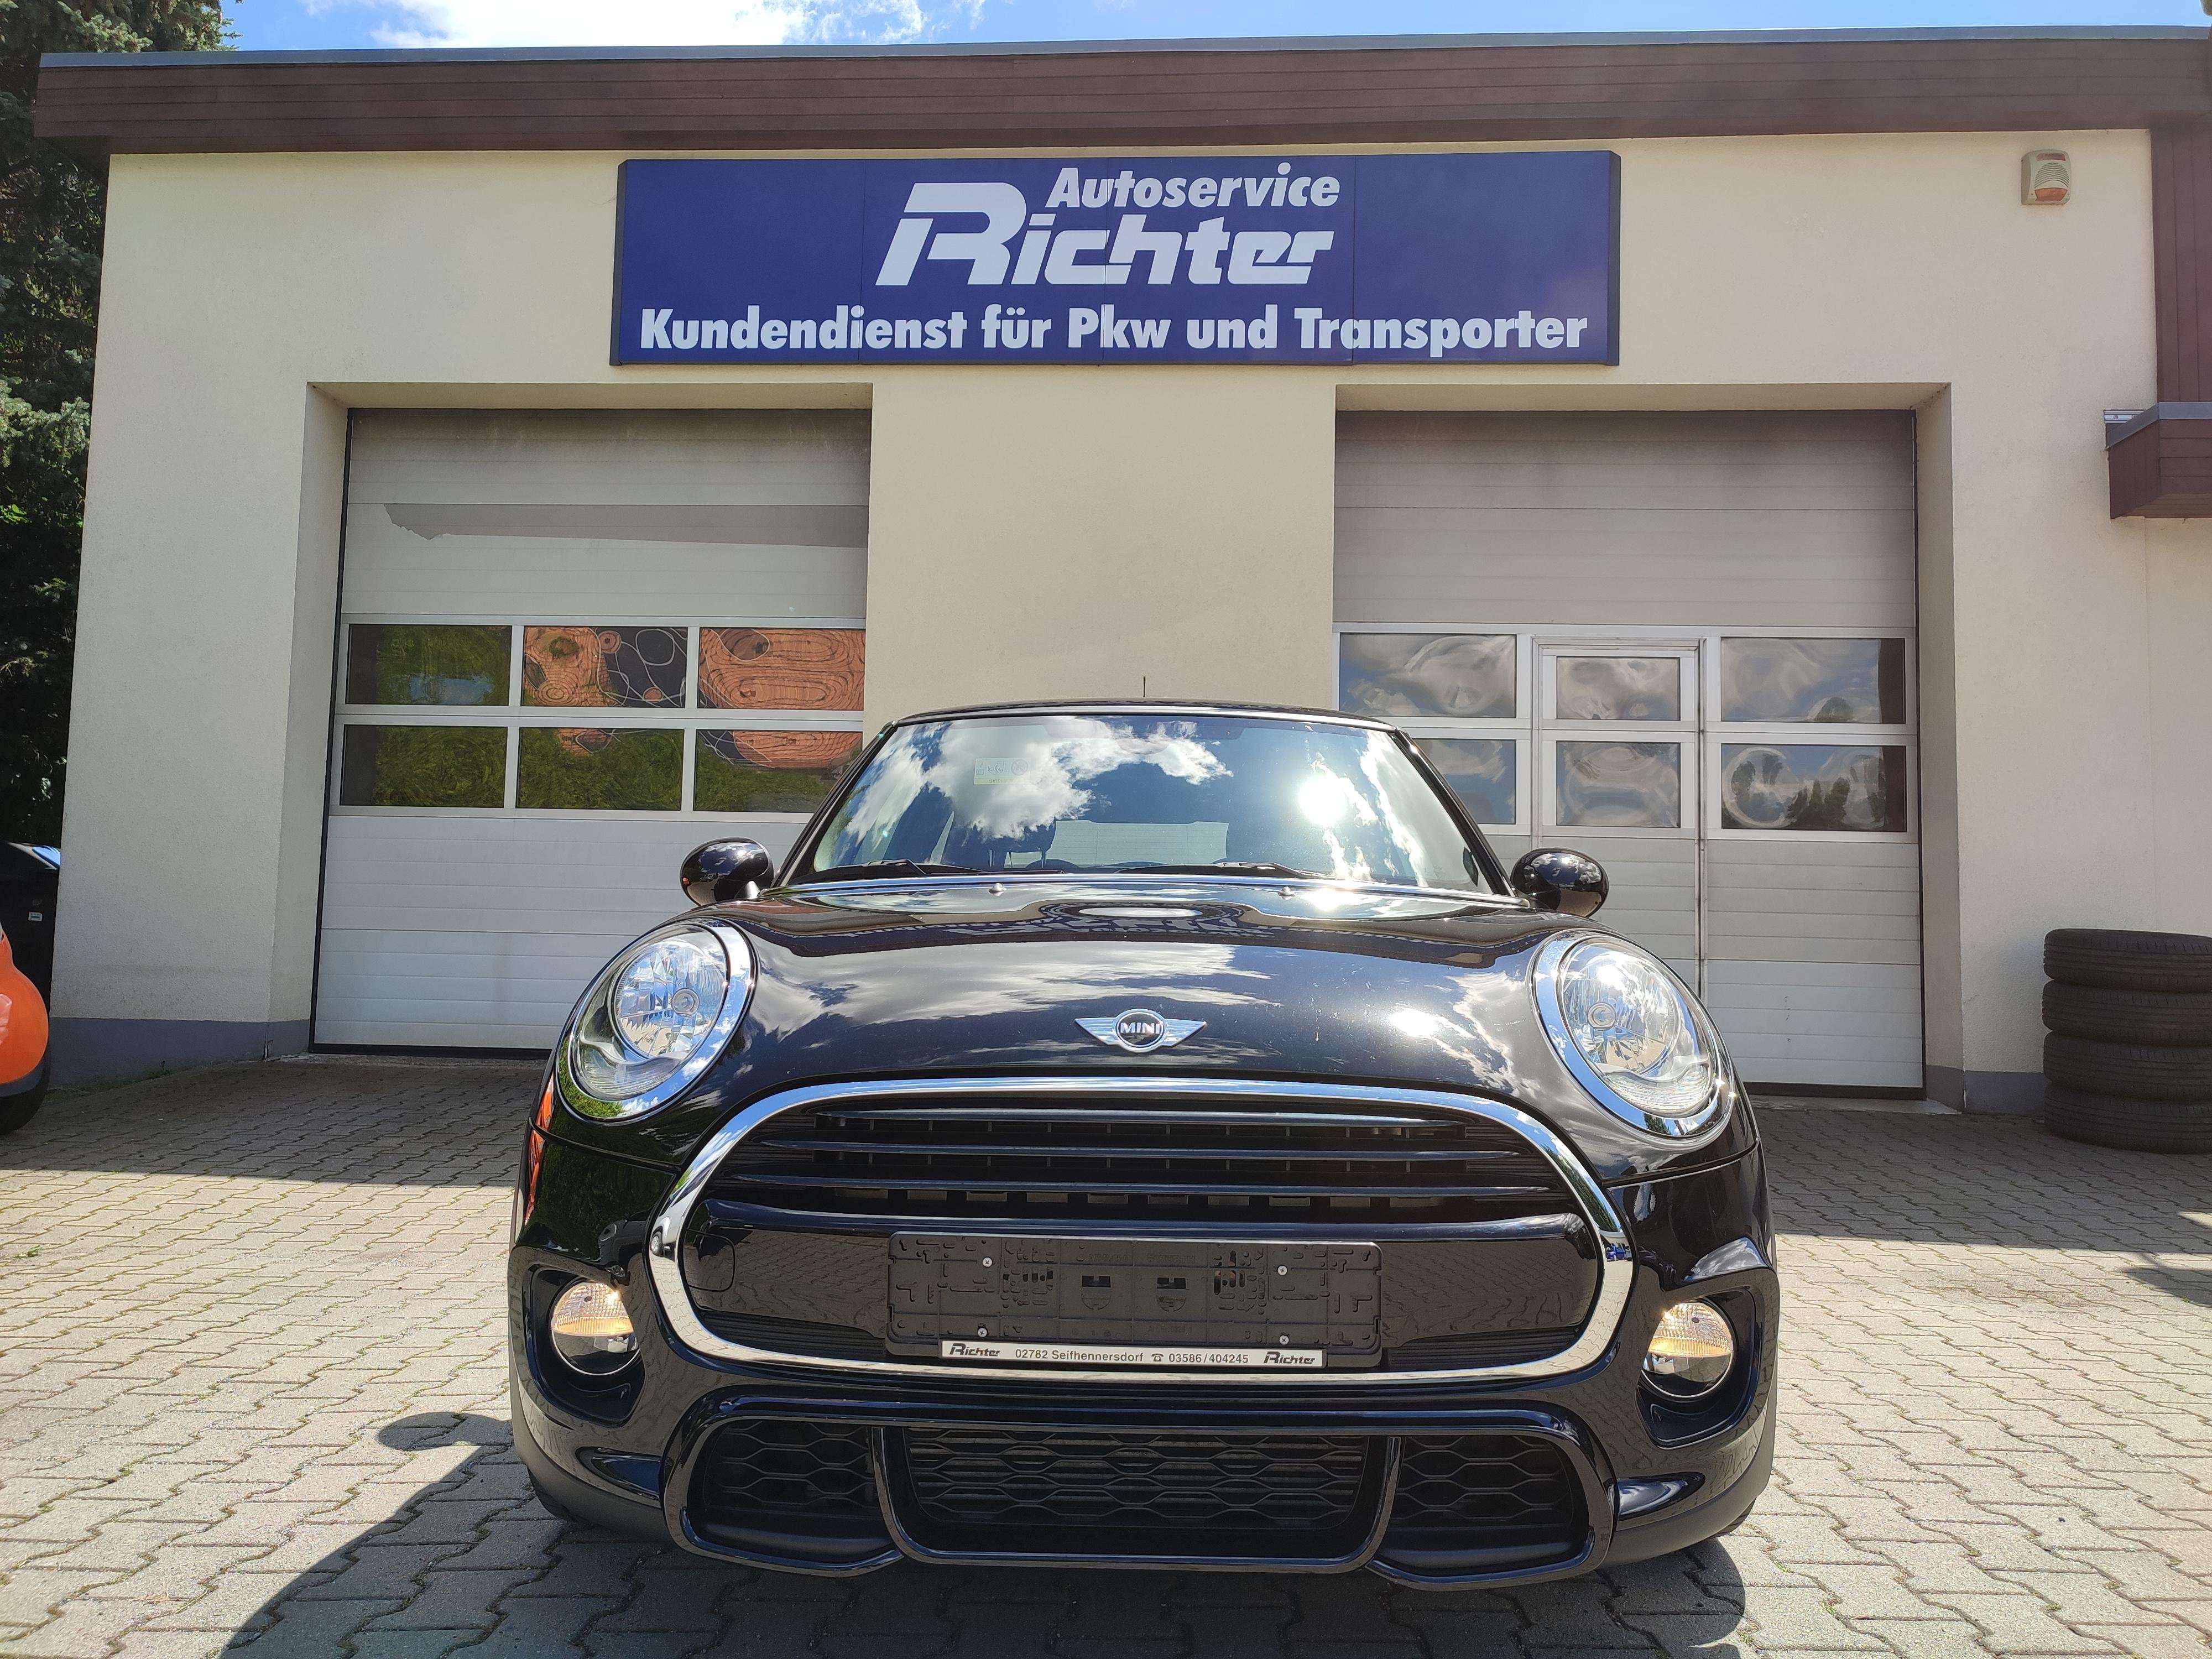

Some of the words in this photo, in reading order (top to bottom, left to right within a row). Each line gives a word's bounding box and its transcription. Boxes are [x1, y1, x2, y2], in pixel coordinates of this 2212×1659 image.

[1045, 163, 1340, 208] Autoservice
[875, 182, 1334, 286] Richter
[640, 305, 967, 349] Kundendienst
[981, 304, 1052, 349] für
[1068, 304, 1172, 348] Pkw
[1187, 304, 1278, 349] und
[1294, 307, 1588, 357] Transporter
[1120, 1022, 1160, 1035] MINI
[949, 1343, 1001, 1358] Richter
[1015, 1349, 1048, 1359] 02782
[1052, 1349, 1144, 1362] Seifhennersdorf
[1168, 1353, 1249, 1364] 03586/404245
[1263, 1351, 1316, 1365] Richter
